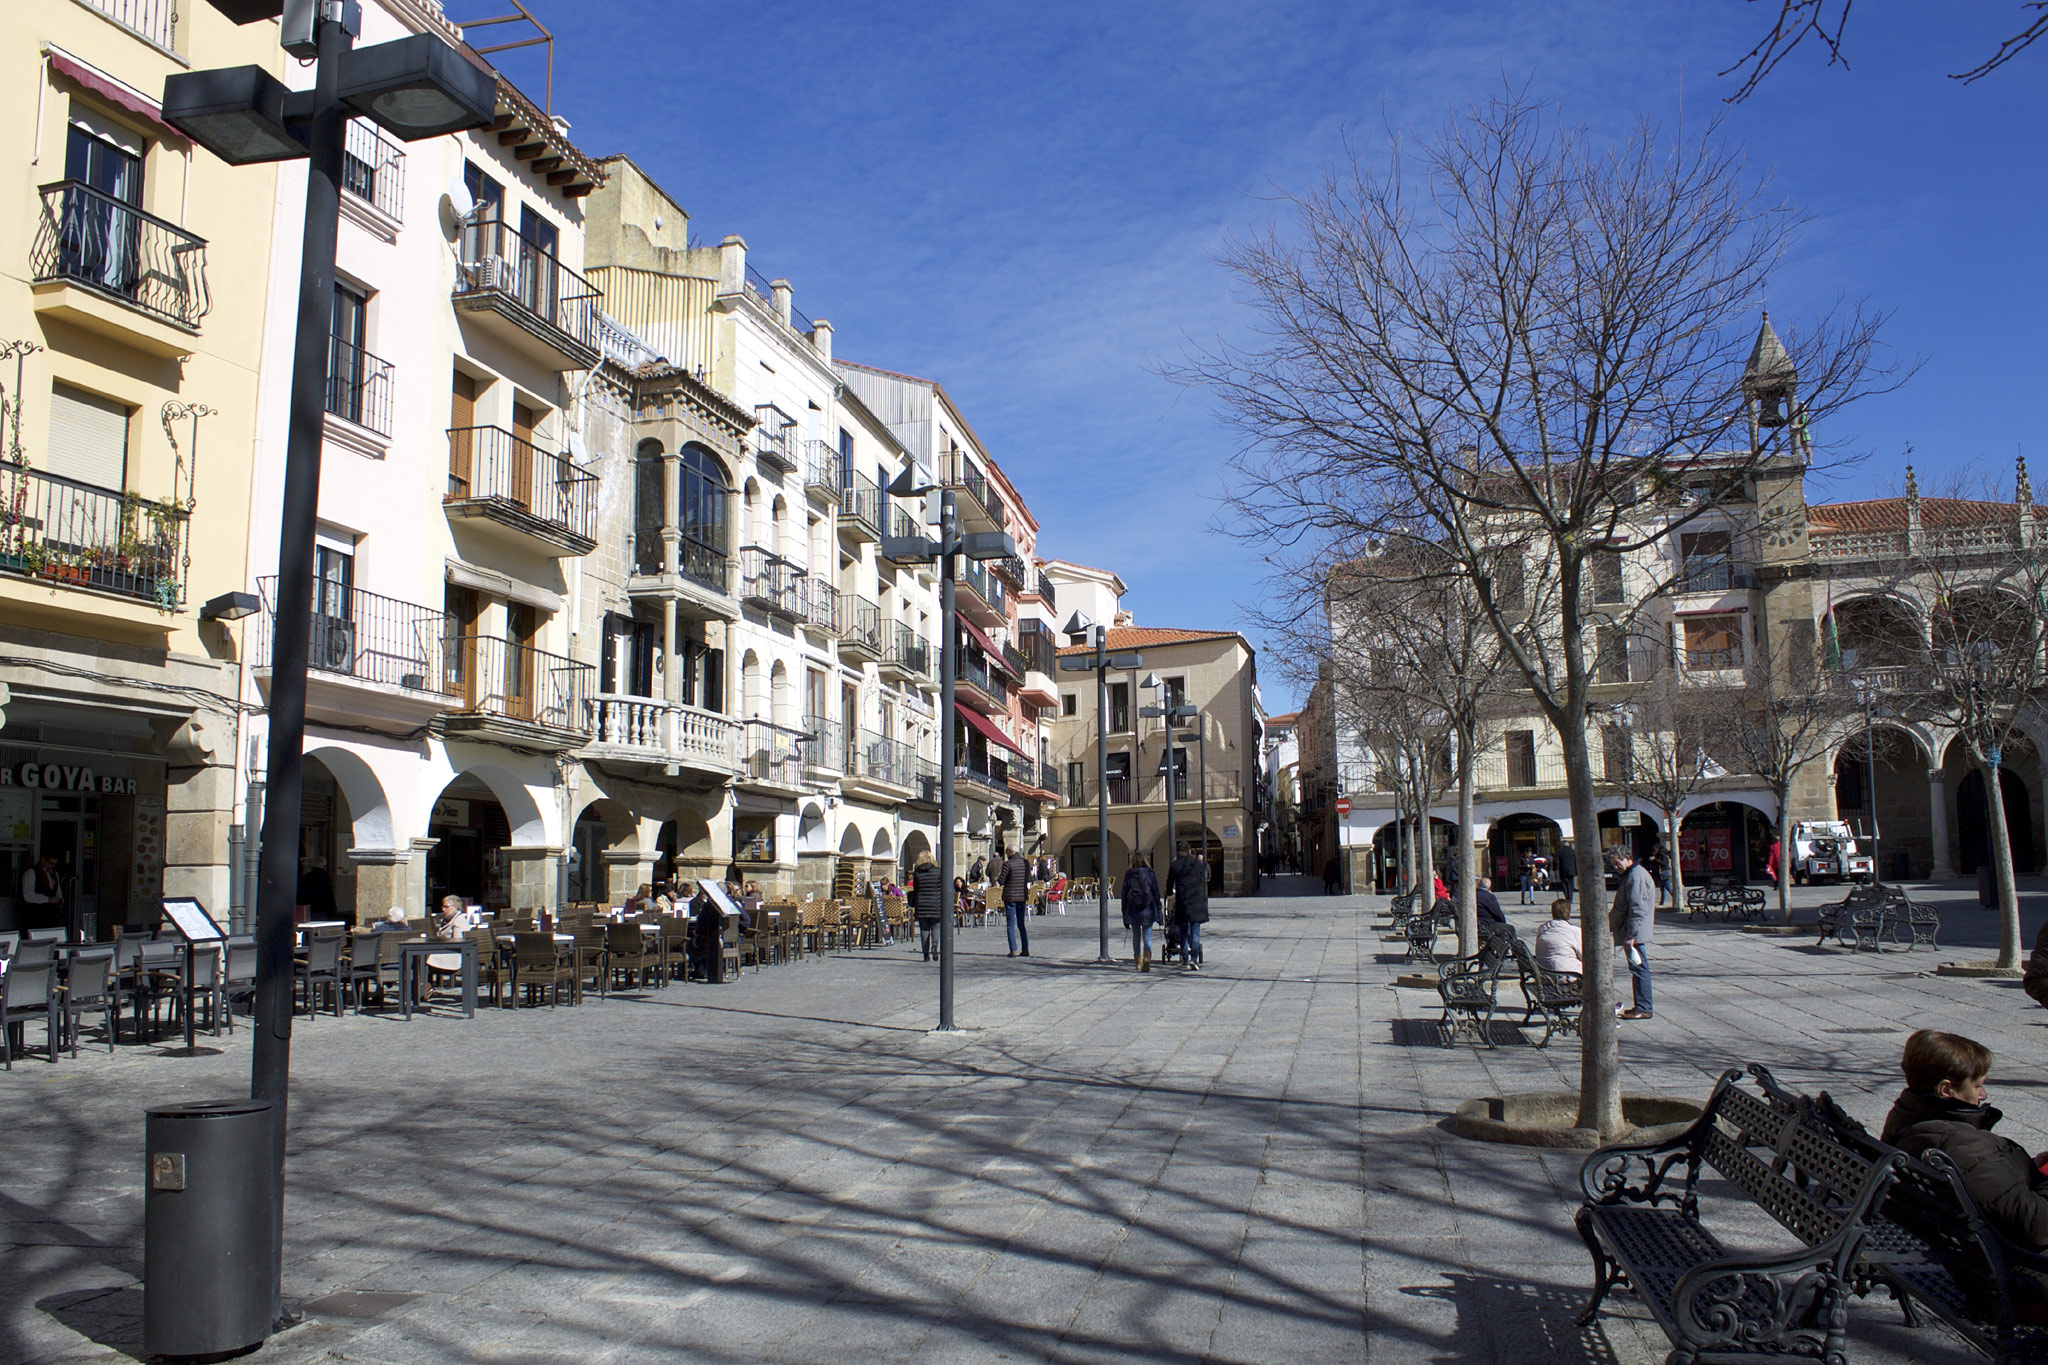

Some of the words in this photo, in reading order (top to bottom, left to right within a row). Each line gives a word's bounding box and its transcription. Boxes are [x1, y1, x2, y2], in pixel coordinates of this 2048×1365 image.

[21, 762, 96, 792] GOYA
[102, 776, 137, 795] BAR
[1680, 848, 1697, 861] 70
[1711, 847, 1729, 860] 70
